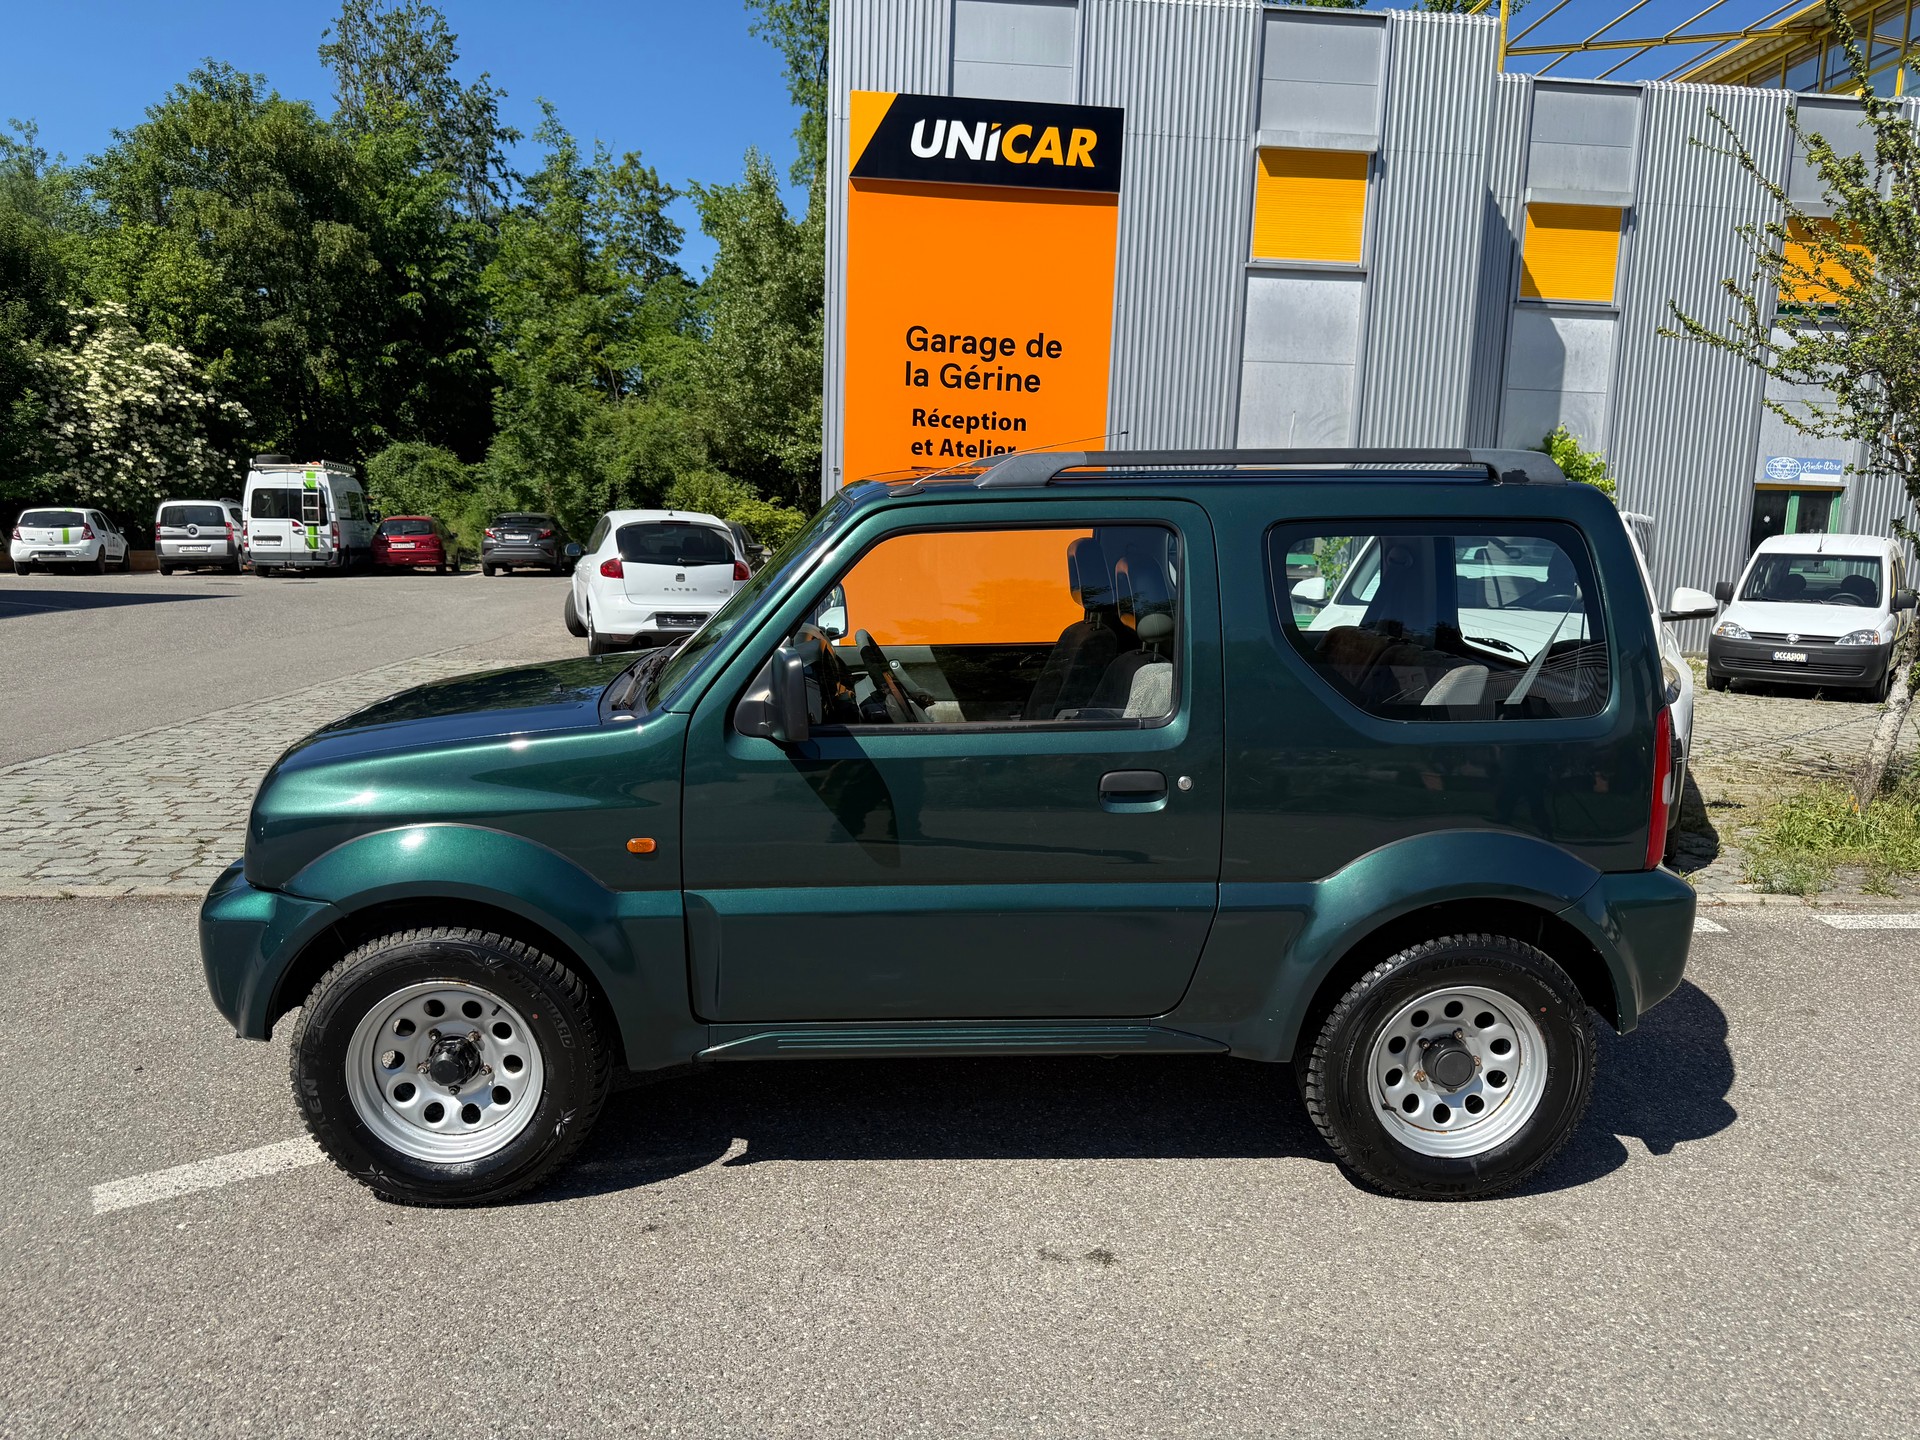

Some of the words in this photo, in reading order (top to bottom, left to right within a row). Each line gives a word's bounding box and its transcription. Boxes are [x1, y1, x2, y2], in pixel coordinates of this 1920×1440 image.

[905, 325, 1016, 362] Garage
[1026, 332, 1063, 359] de
[905, 361, 929, 387] la
[939, 363, 1041, 393] Gérine
[912, 408, 1027, 434] Réception
[911, 439, 934, 456] et
[1774, 651, 1806, 662] OCCASION
